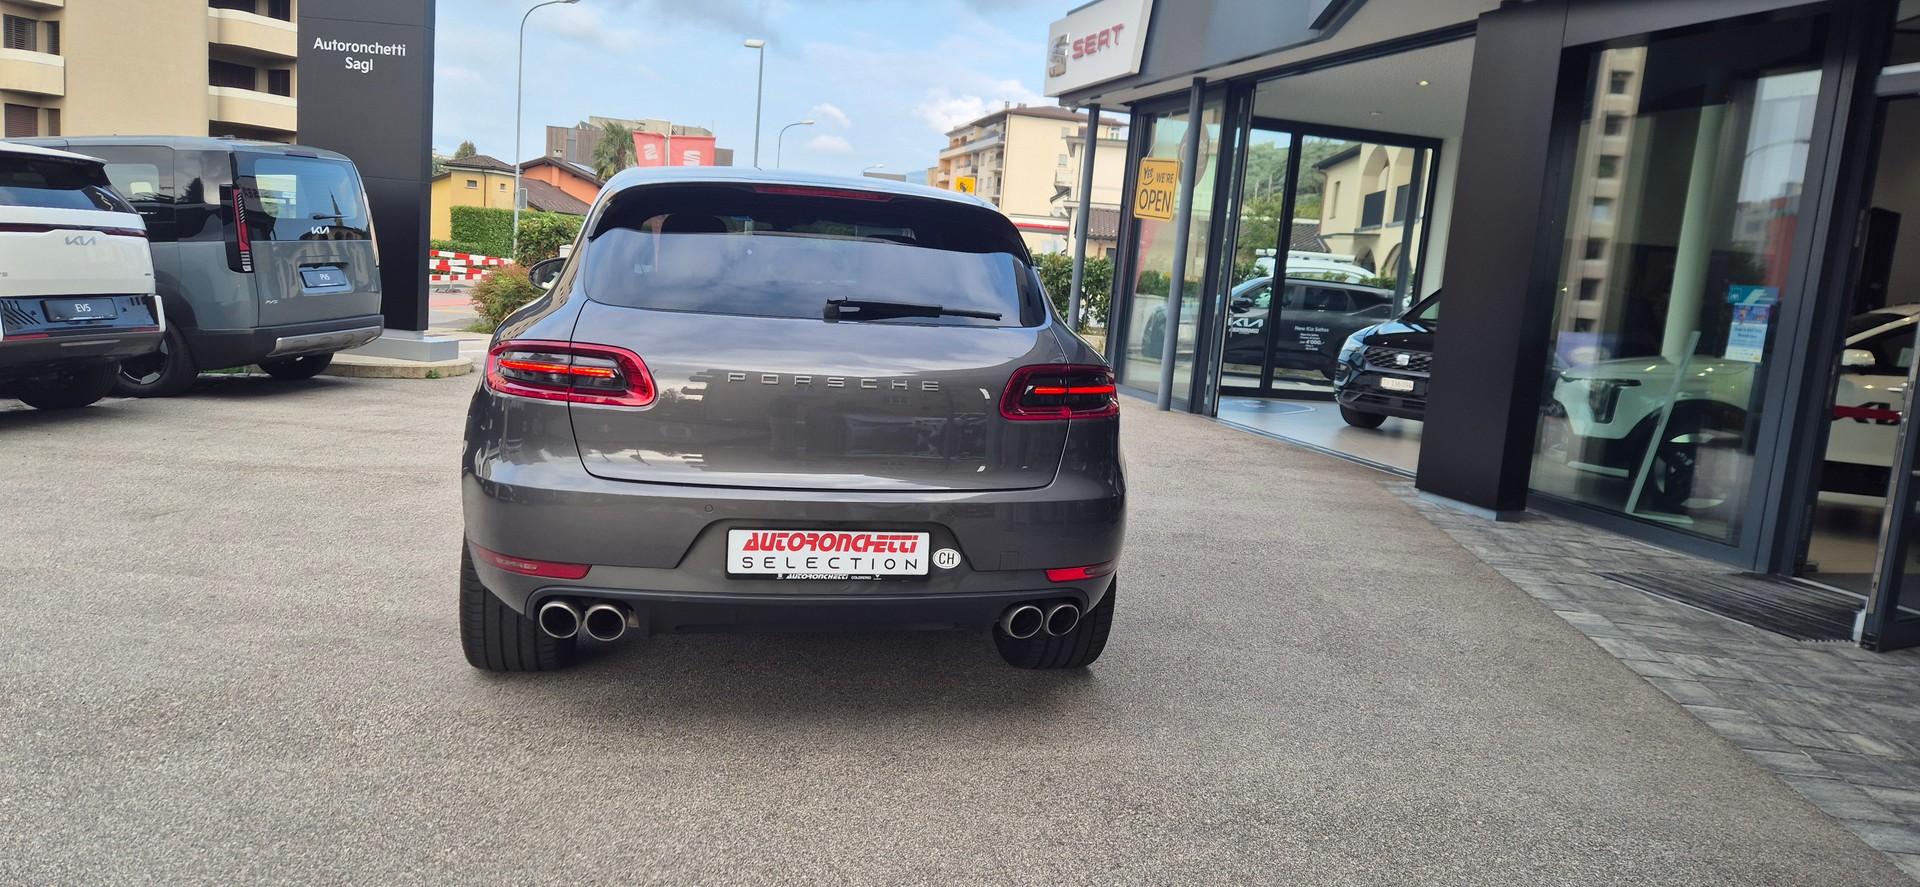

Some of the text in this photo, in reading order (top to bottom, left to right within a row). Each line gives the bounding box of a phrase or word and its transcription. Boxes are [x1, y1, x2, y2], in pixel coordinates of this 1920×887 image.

[313, 37, 406, 56] Autoronchetti
[1072, 23, 1125, 59] SEAT
[345, 57, 373, 73] Sagl
[1144, 166, 1174, 183] YES WE'RE
[1140, 188, 1172, 212] OPEN
[311, 226, 330, 234] KIA
[65, 235, 97, 246] KIA
[75, 303, 92, 312] EV5
[728, 372, 939, 391] PORSCHE
[743, 532, 919, 553] AUTORONCHETTI
[742, 556, 917, 570] SELECTION
[938, 551, 955, 565] CH
